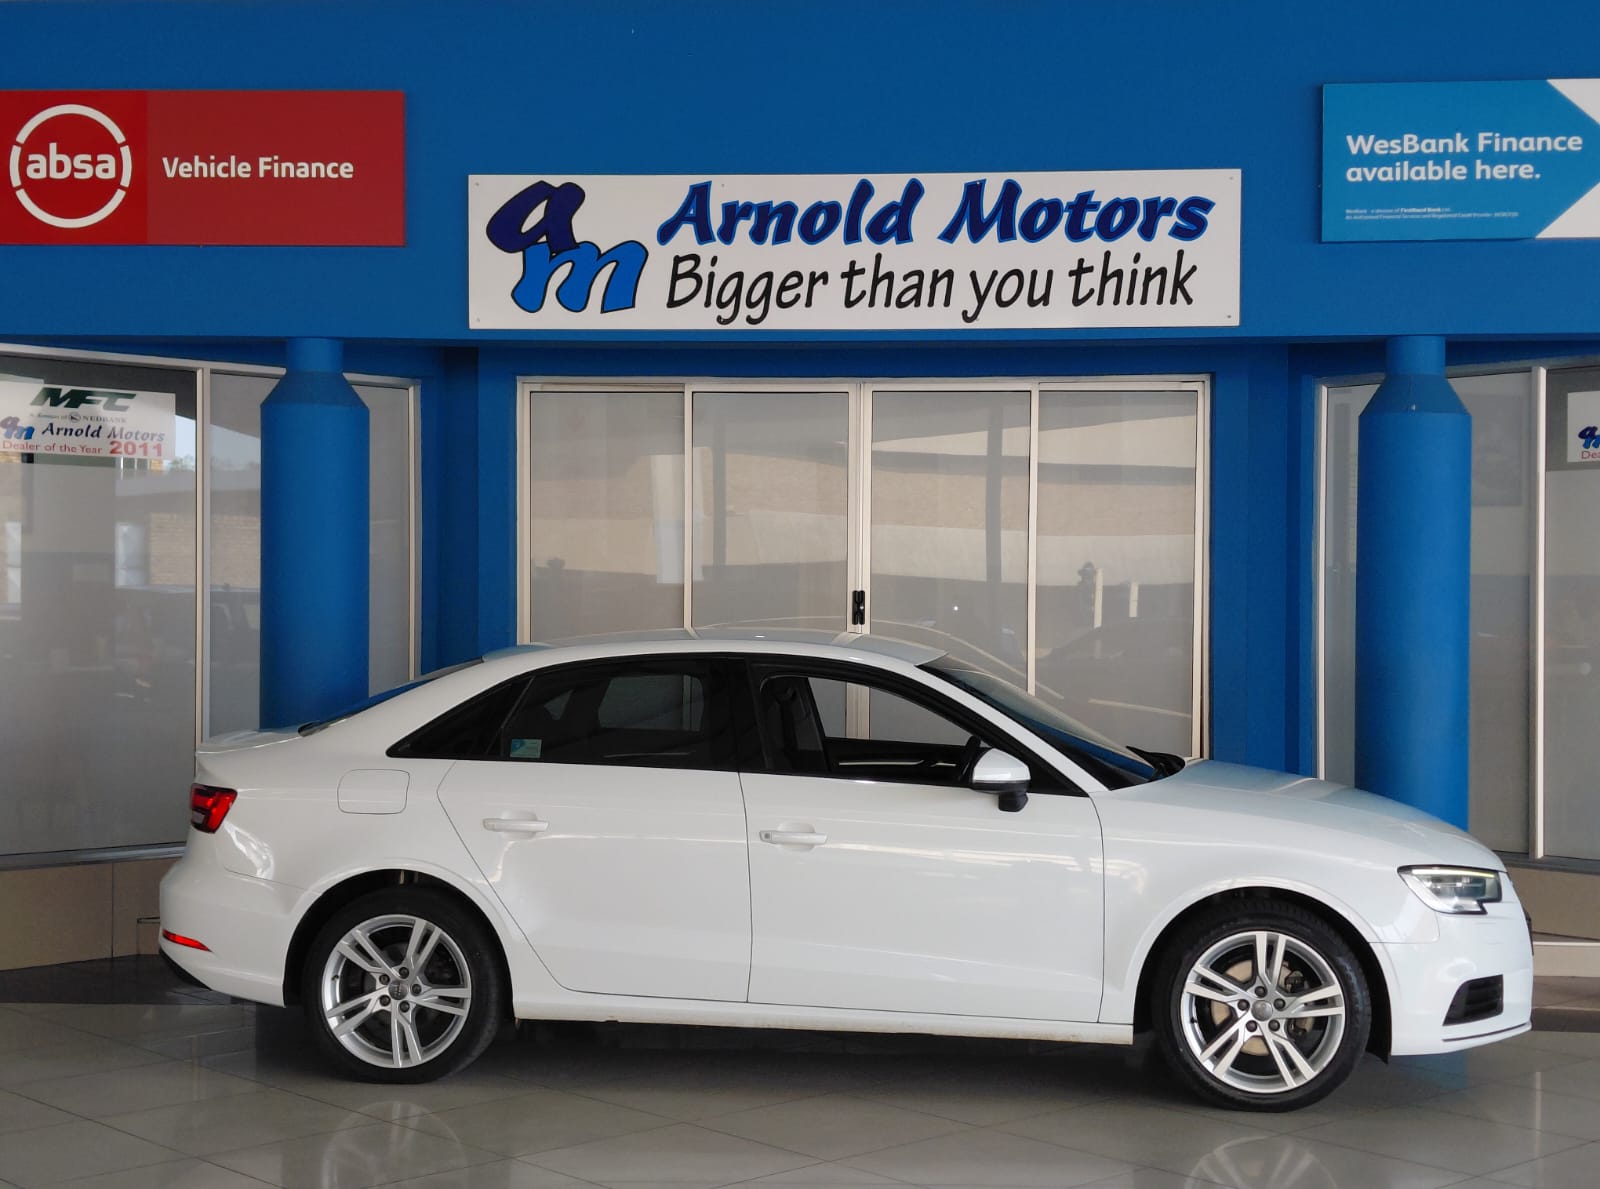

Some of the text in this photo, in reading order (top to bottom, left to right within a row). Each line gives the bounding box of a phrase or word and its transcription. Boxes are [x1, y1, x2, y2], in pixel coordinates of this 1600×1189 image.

[1346, 131, 1583, 155] WesBank Finance
[26, 142, 117, 180] absa
[162, 155, 354, 179] Vehicle Finance
[1346, 160, 1541, 182] available here.
[656, 177, 1216, 246] Arnold Motors
[666, 249, 1198, 326] Bigger than you think
[30, 387, 137, 412] MFC
[42, 422, 166, 442] Arnold Motors
[2, 441, 163, 457] Dealer of the Year 2011
